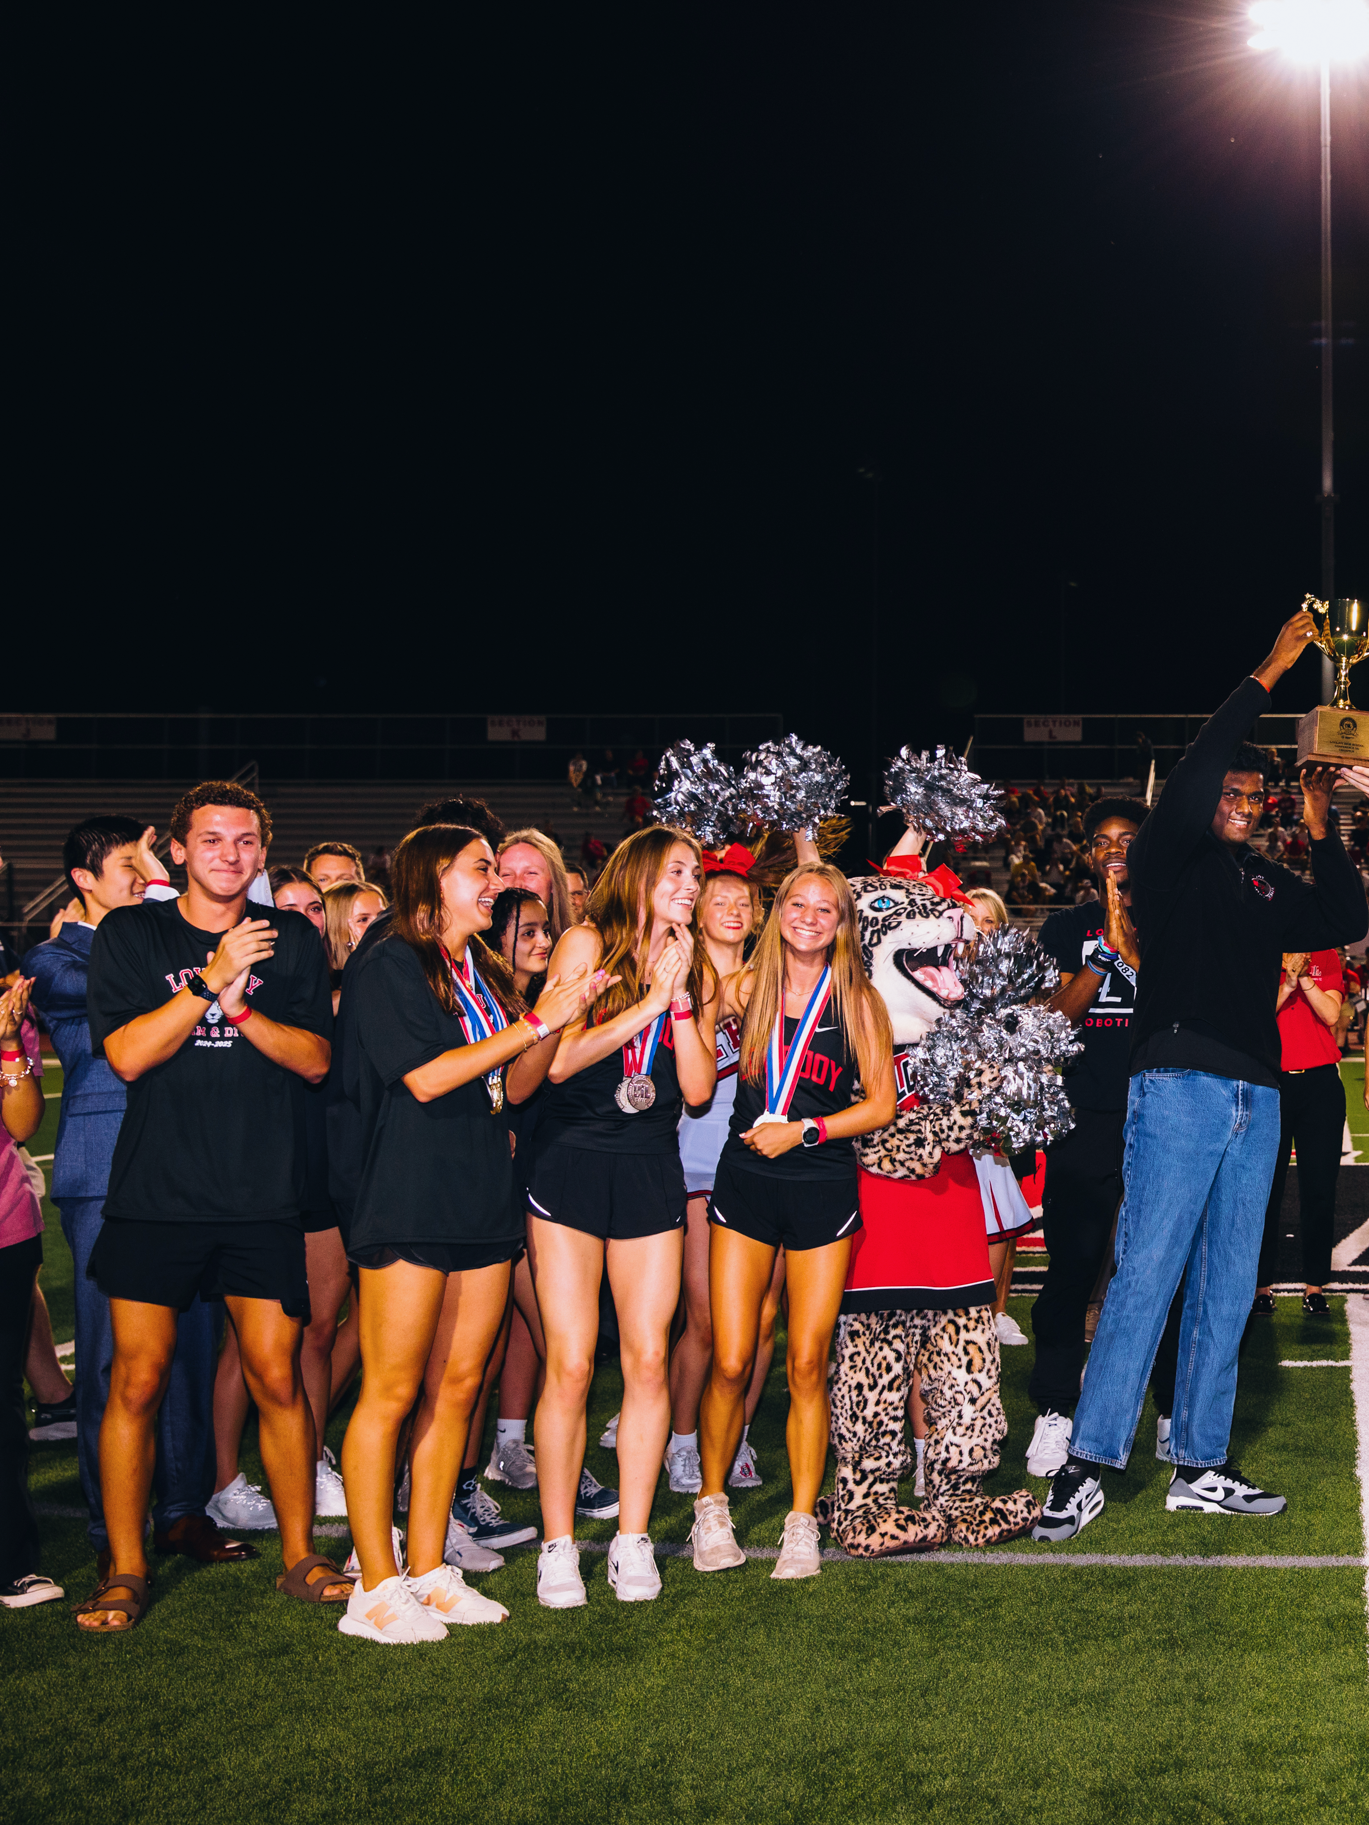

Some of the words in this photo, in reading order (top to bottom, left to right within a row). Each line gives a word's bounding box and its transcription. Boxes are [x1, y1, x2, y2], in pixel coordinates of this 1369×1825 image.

[489, 719, 545, 727] SECTION
[1026, 719, 1081, 728] SECTION
[511, 728, 521, 739] K
[1048, 729, 1057, 740] L
[1085, 1018, 1129, 1028] OBOTI
[210, 1026, 221, 1038] &
[194, 1039, 233, 1048] 2024-2025
